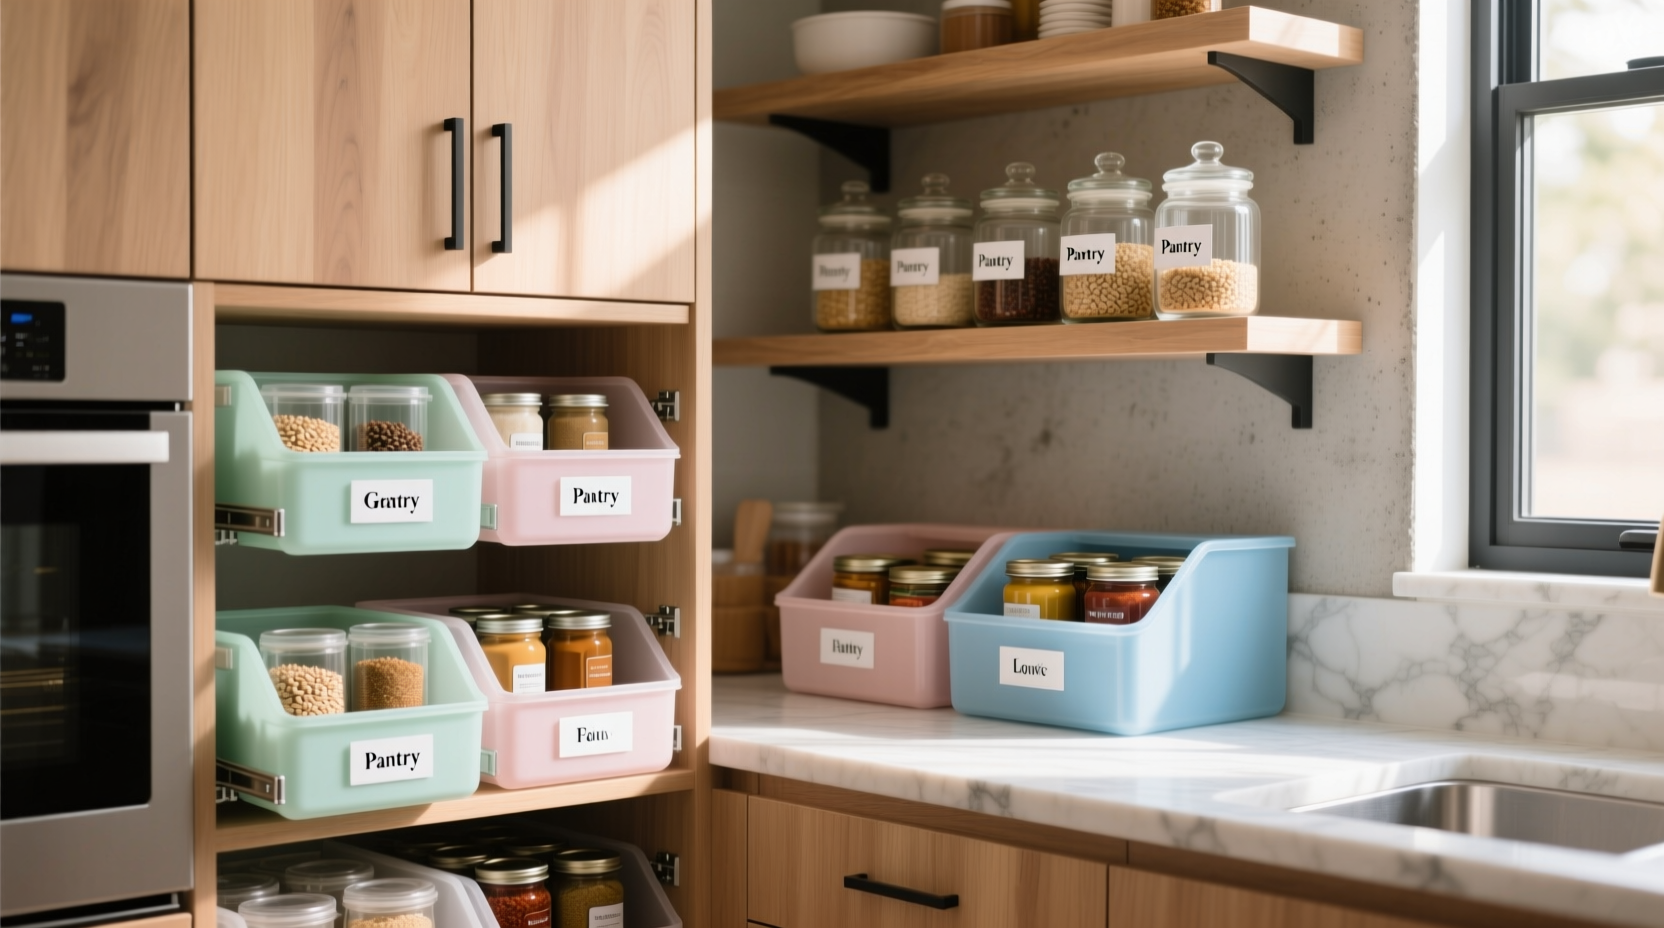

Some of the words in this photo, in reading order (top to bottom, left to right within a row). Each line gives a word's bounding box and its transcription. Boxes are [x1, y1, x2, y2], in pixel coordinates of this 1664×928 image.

[1161, 238, 1202, 258] Pantry
[573, 487, 619, 508] Pantry
[365, 751, 421, 772] Pantry
